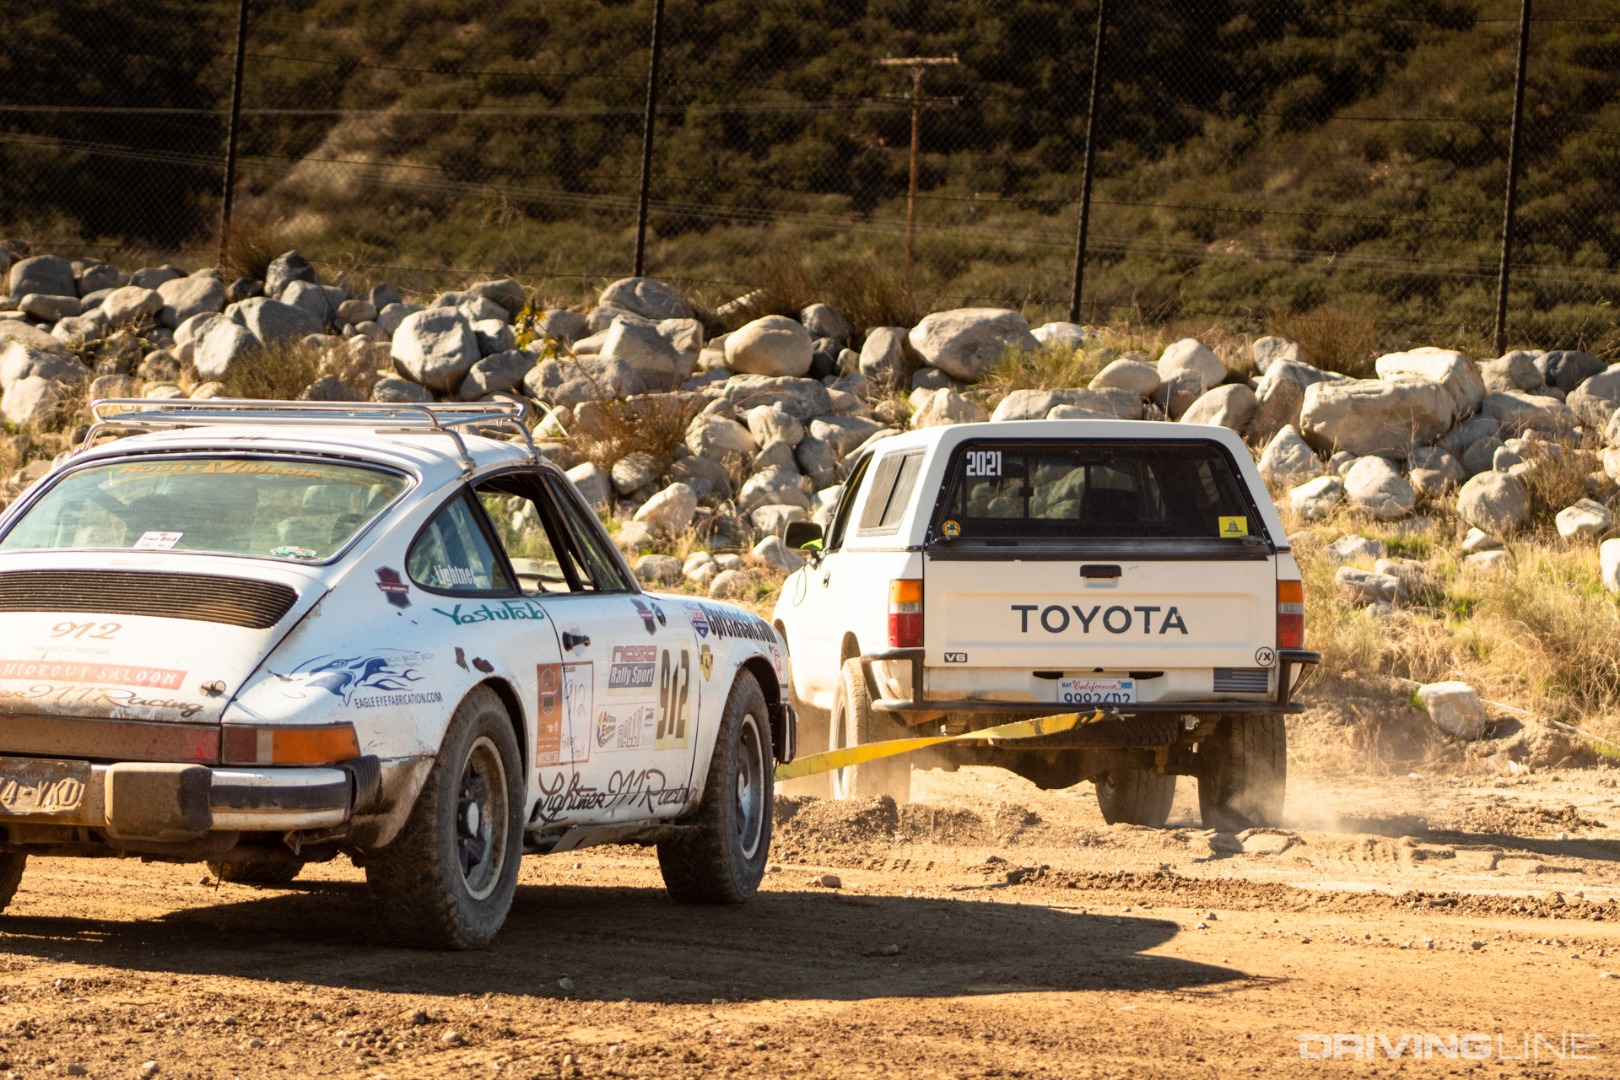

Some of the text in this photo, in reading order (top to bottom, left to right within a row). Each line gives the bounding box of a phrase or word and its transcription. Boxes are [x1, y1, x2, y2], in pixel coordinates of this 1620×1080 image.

[966, 451, 1002, 476] 2021
[1011, 604, 1189, 634] TOYOTA
[51, 621, 122, 640] 912
[945, 653, 966, 662] V6
[3, 663, 178, 686] HIDEOUT SALOON
[610, 666, 654, 685] Rally Sport
[656, 649, 689, 740] 912
[1073, 680, 1120, 692] California
